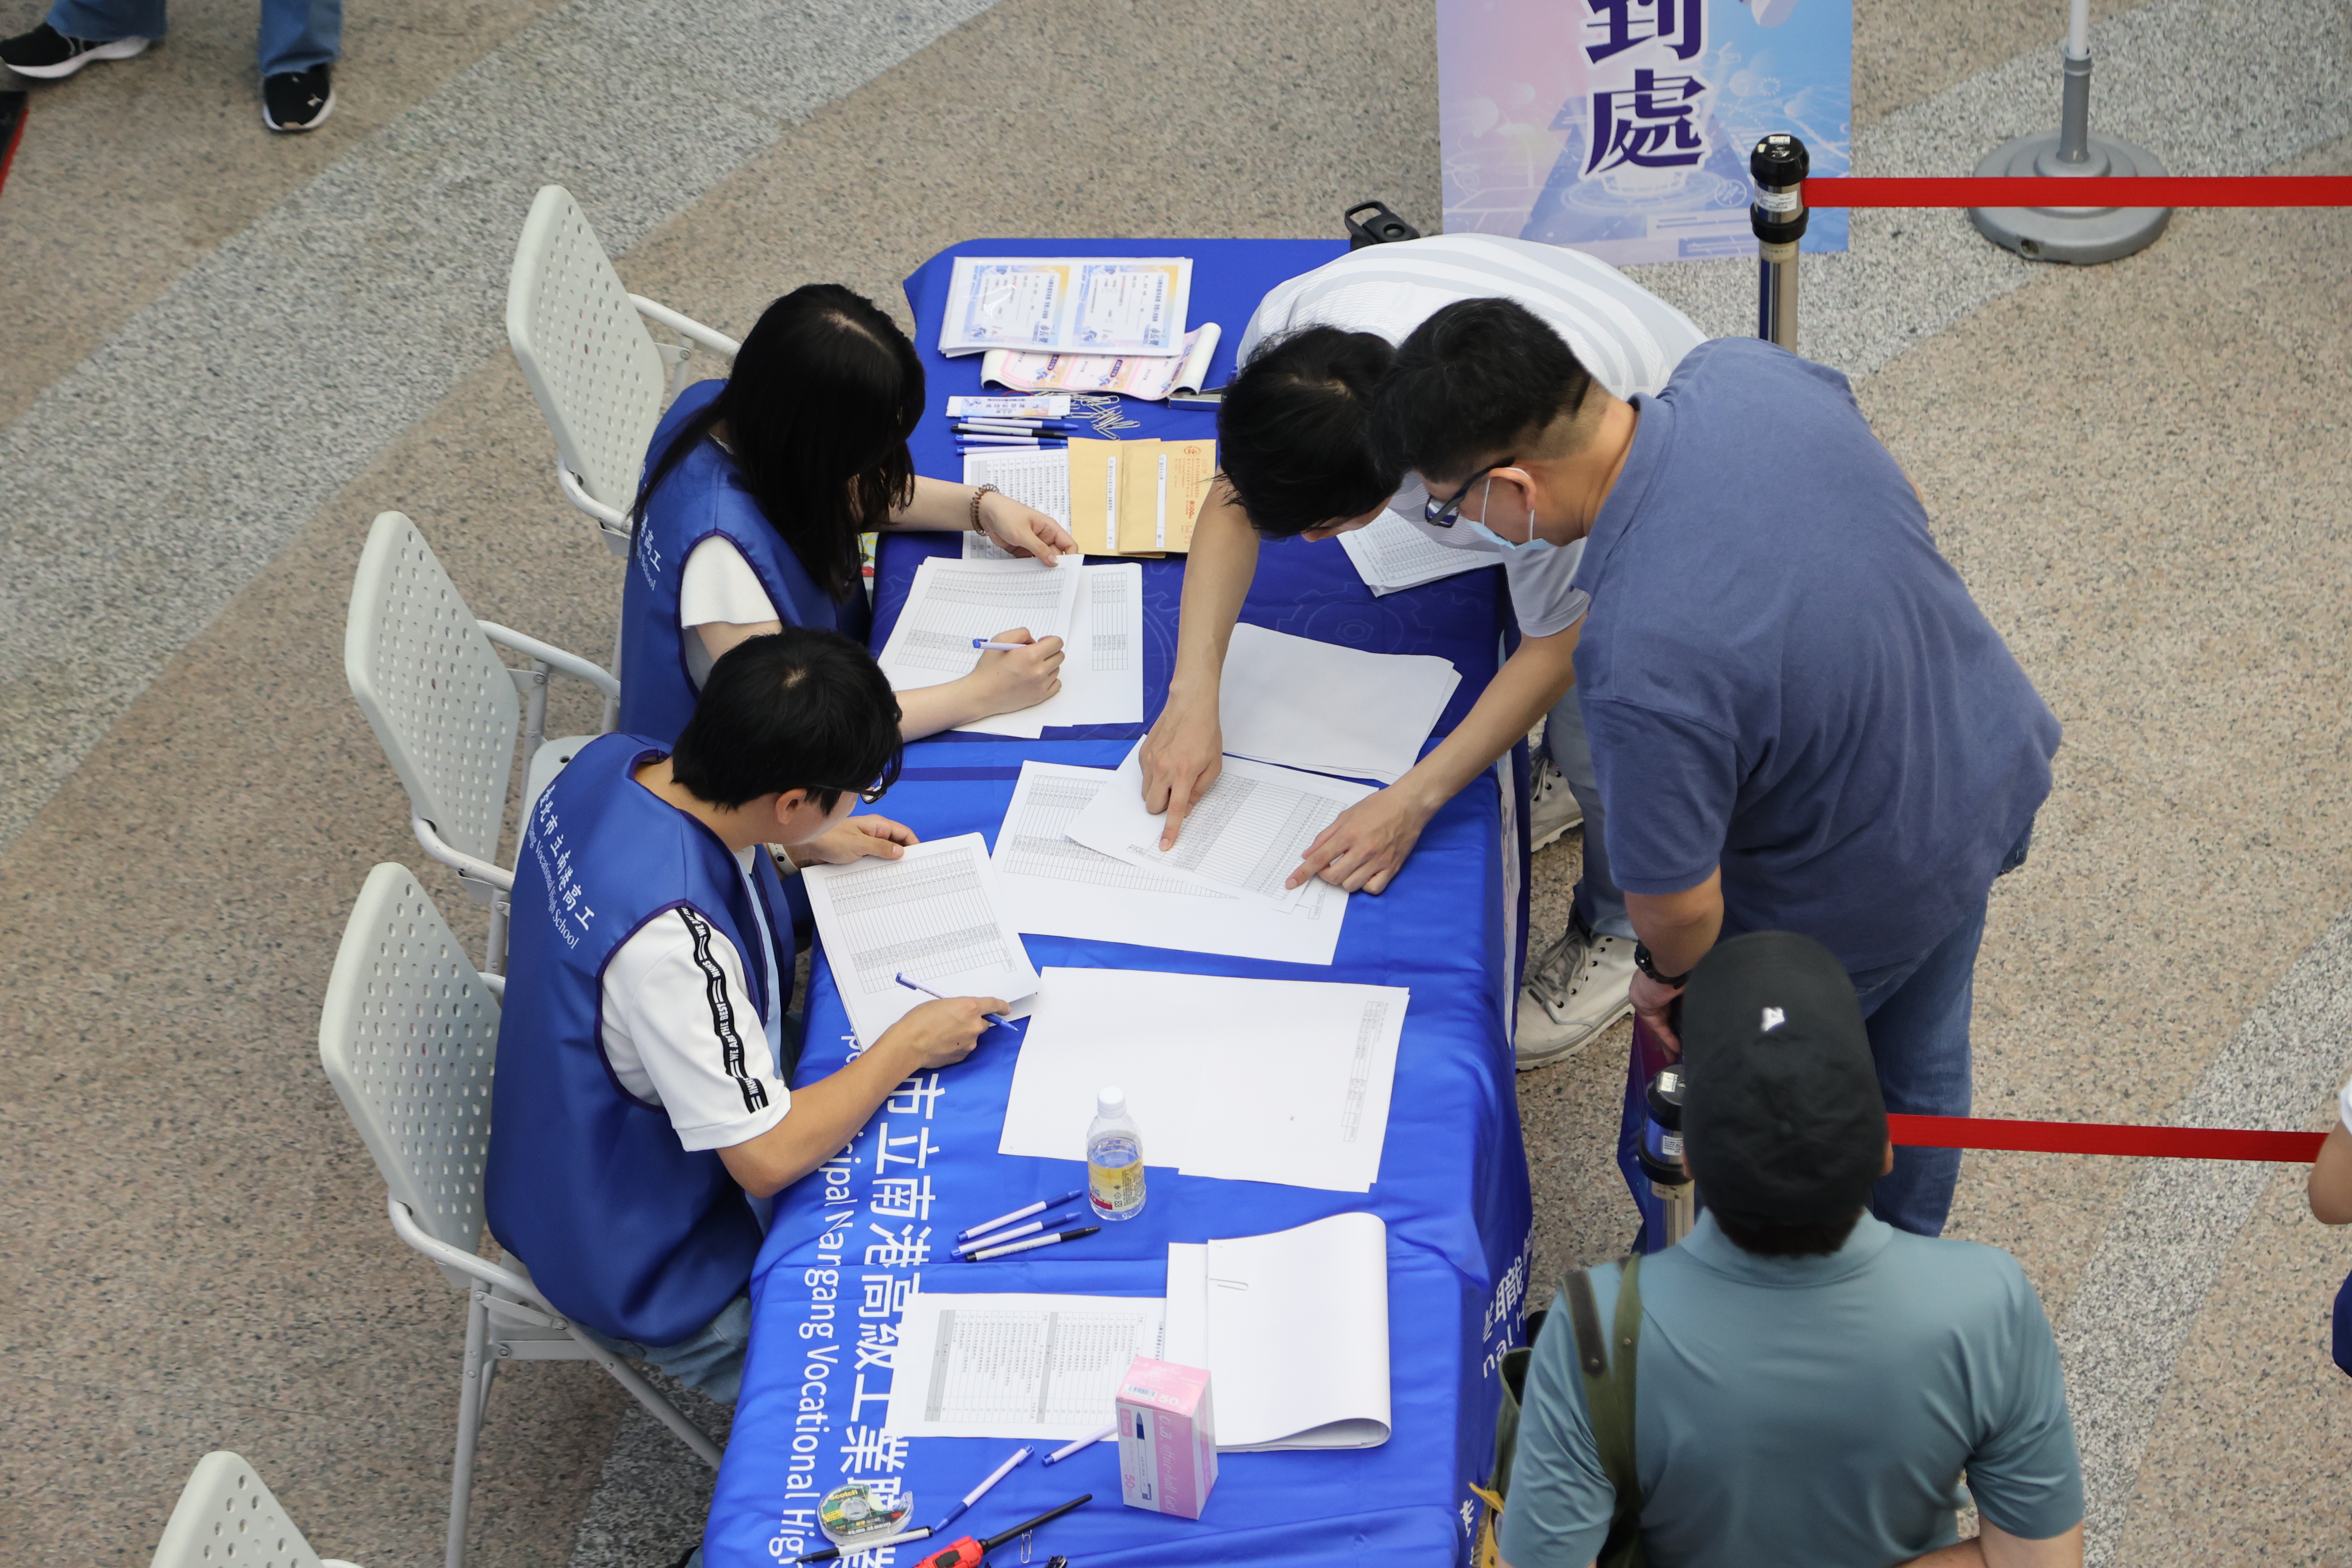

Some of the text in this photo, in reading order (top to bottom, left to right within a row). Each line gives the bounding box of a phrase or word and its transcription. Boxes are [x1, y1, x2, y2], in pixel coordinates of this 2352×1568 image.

[535, 840, 555, 891] Vocational
[552, 908, 580, 950] School
[695, 924, 707, 937] WE
[702, 960, 721, 978] NKHS
[717, 1003, 729, 1021] BEST
[720, 1021, 731, 1037] THE
[729, 1047, 739, 1062] WE
[799, 1210, 854, 1339] Nangang
[1158, 1393, 1179, 1406] 50
[784, 1345, 839, 1499] Vocational
[1124, 1473, 1136, 1489] 50
[829, 1489, 858, 1501] Scotch
